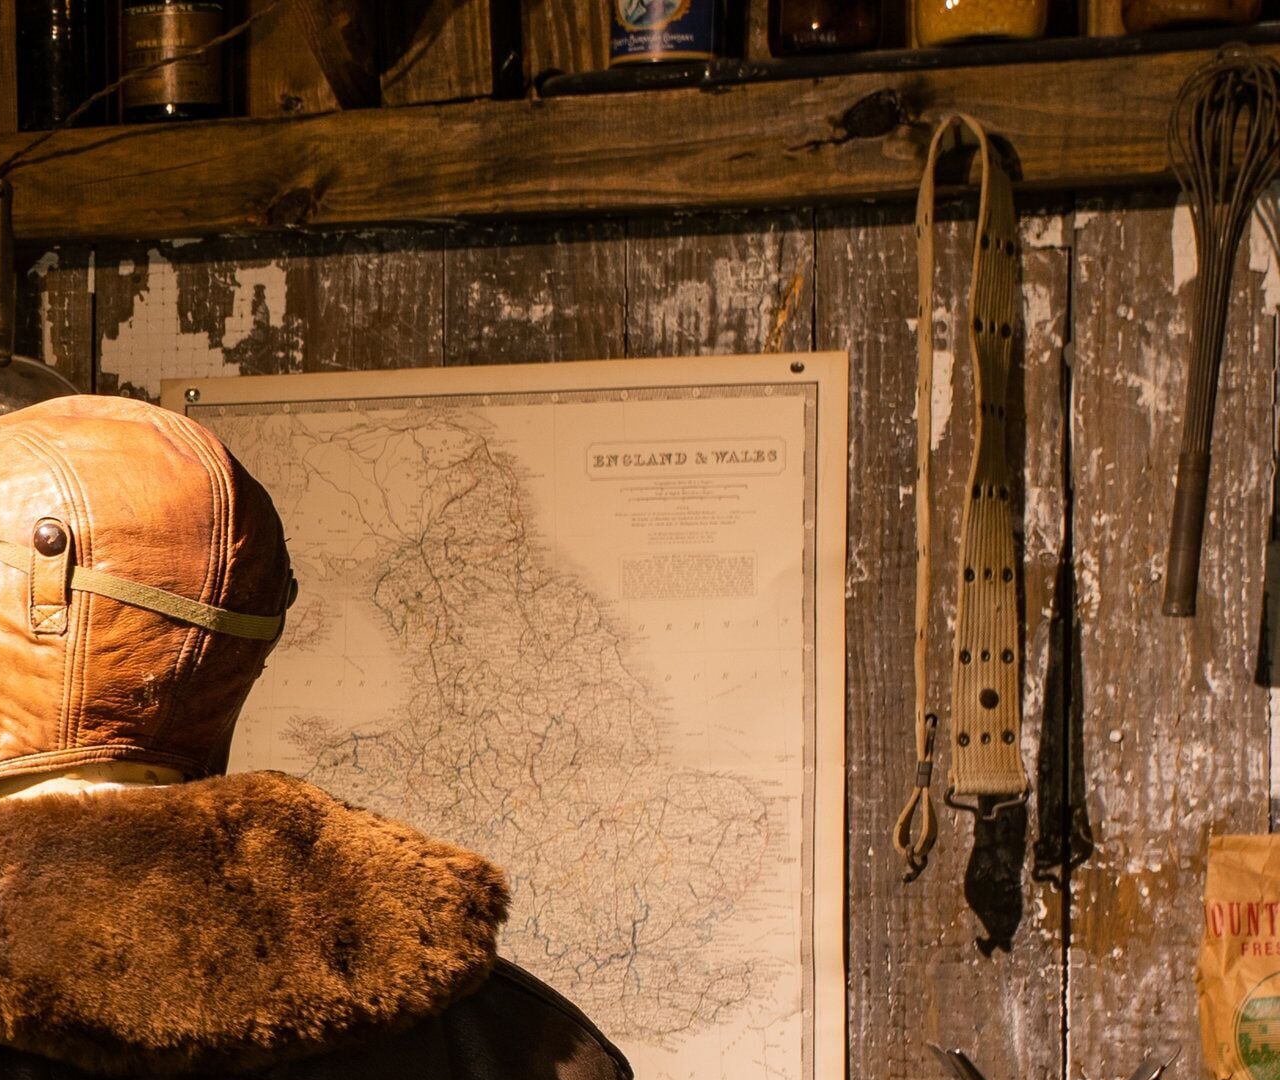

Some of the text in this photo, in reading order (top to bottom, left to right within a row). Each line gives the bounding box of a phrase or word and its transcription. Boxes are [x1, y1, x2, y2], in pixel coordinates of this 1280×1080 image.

[593, 448, 778, 469] ENGLAND & WALES
